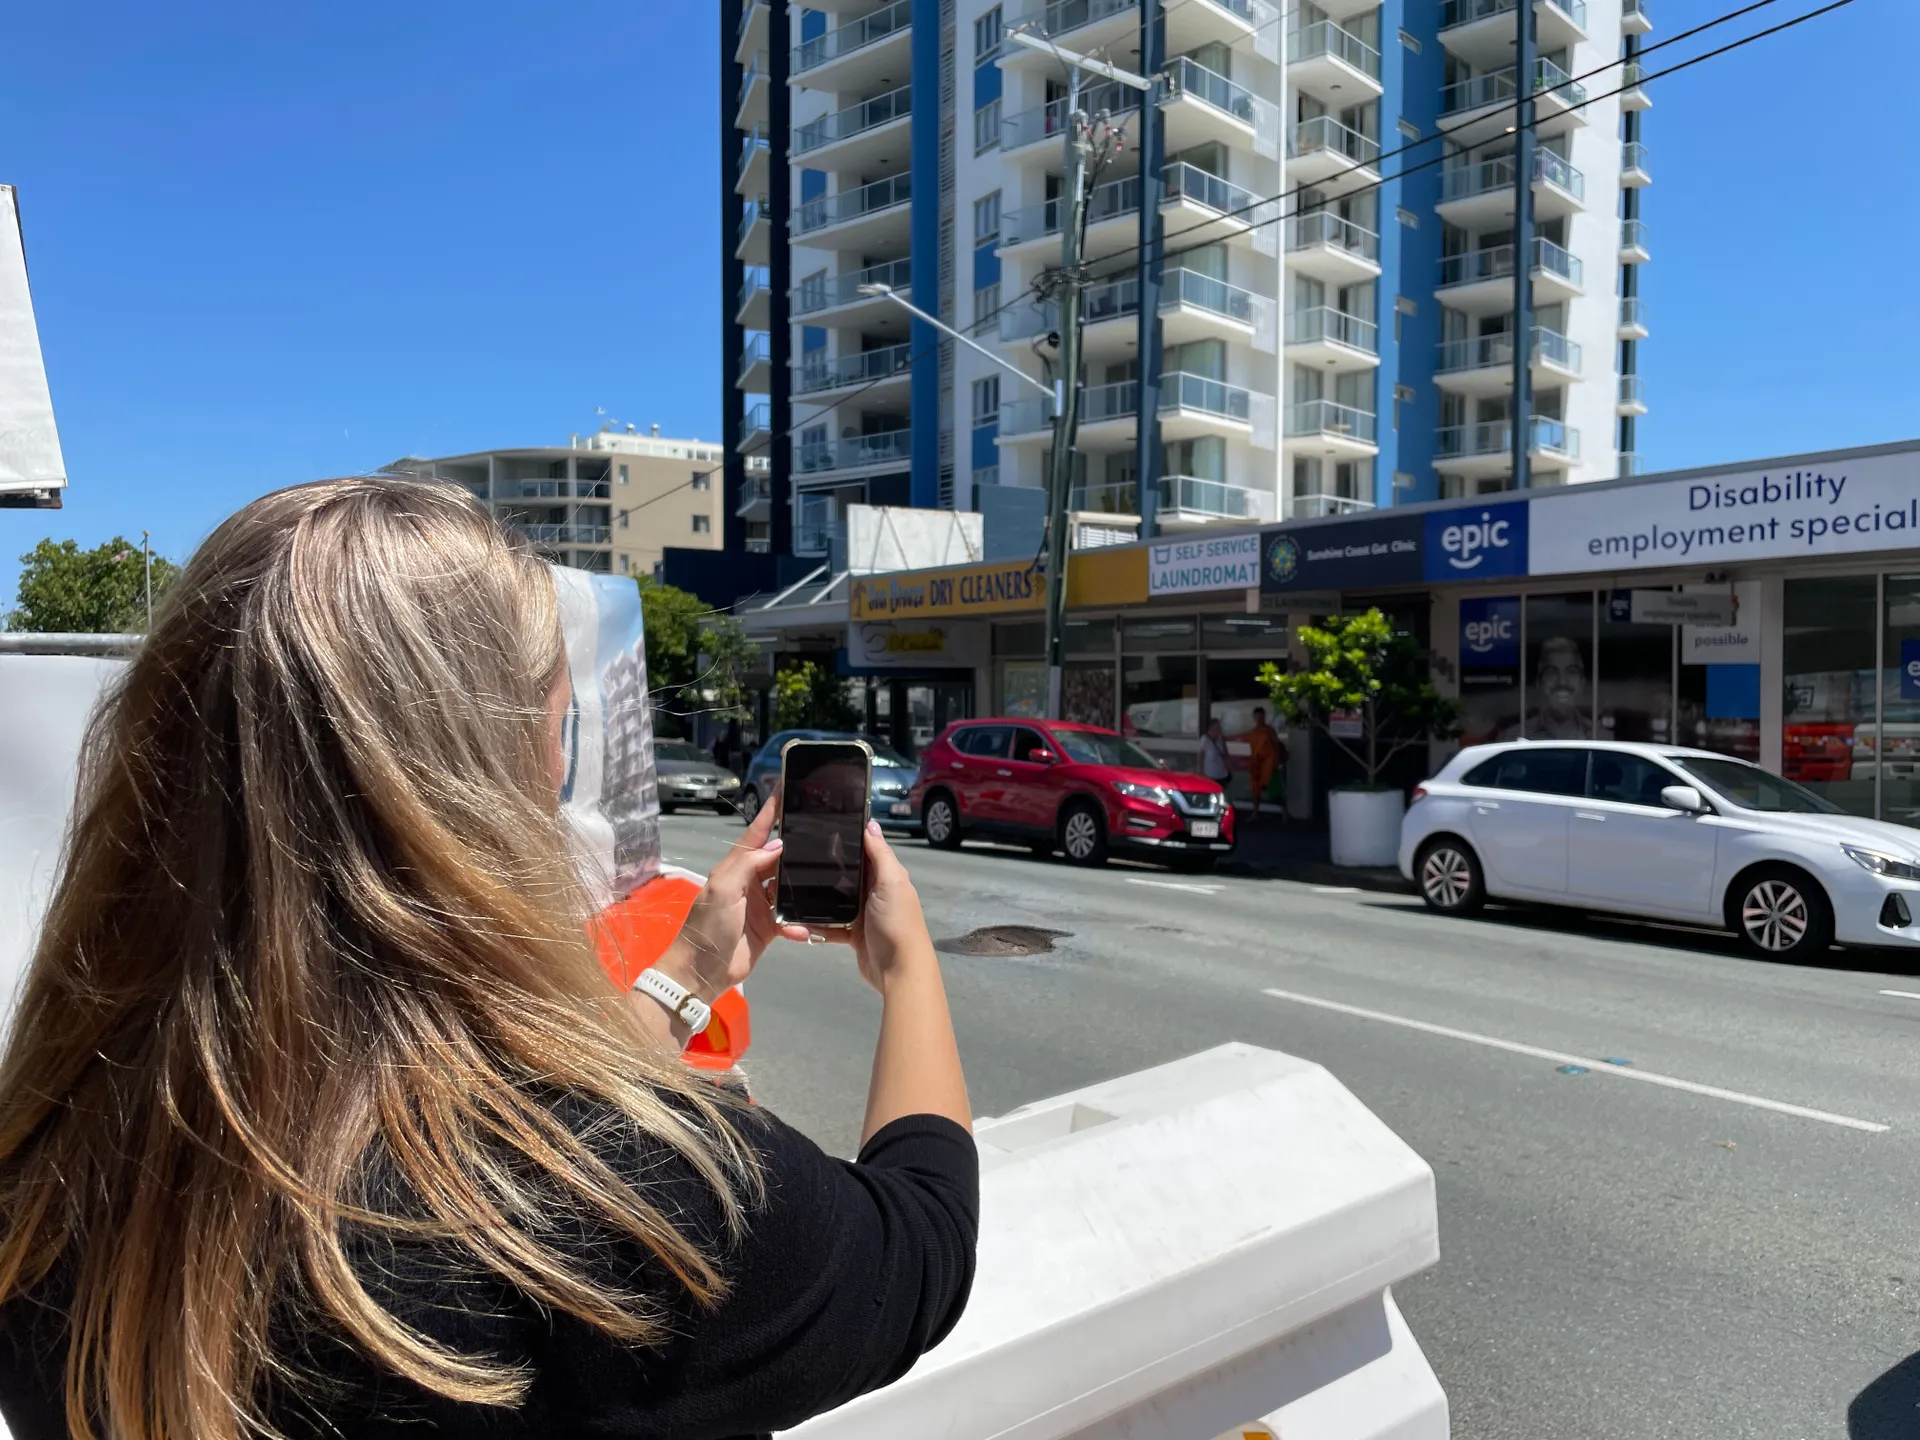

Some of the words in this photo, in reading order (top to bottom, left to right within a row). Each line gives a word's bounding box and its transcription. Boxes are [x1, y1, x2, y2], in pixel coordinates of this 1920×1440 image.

[1688, 471, 1847, 511] Disability
[1175, 543, 1204, 560] SELF
[1206, 537, 1258, 557] SERVICE
[1440, 511, 1510, 560] epic
[1587, 517, 1780, 559] employment
[929, 577, 955, 607] DRY
[959, 570, 1032, 605] CLEANERS
[1150, 562, 1258, 590] LAUNDROMAT
[1464, 613, 1513, 646] epic
[1694, 631, 1749, 649] possible
